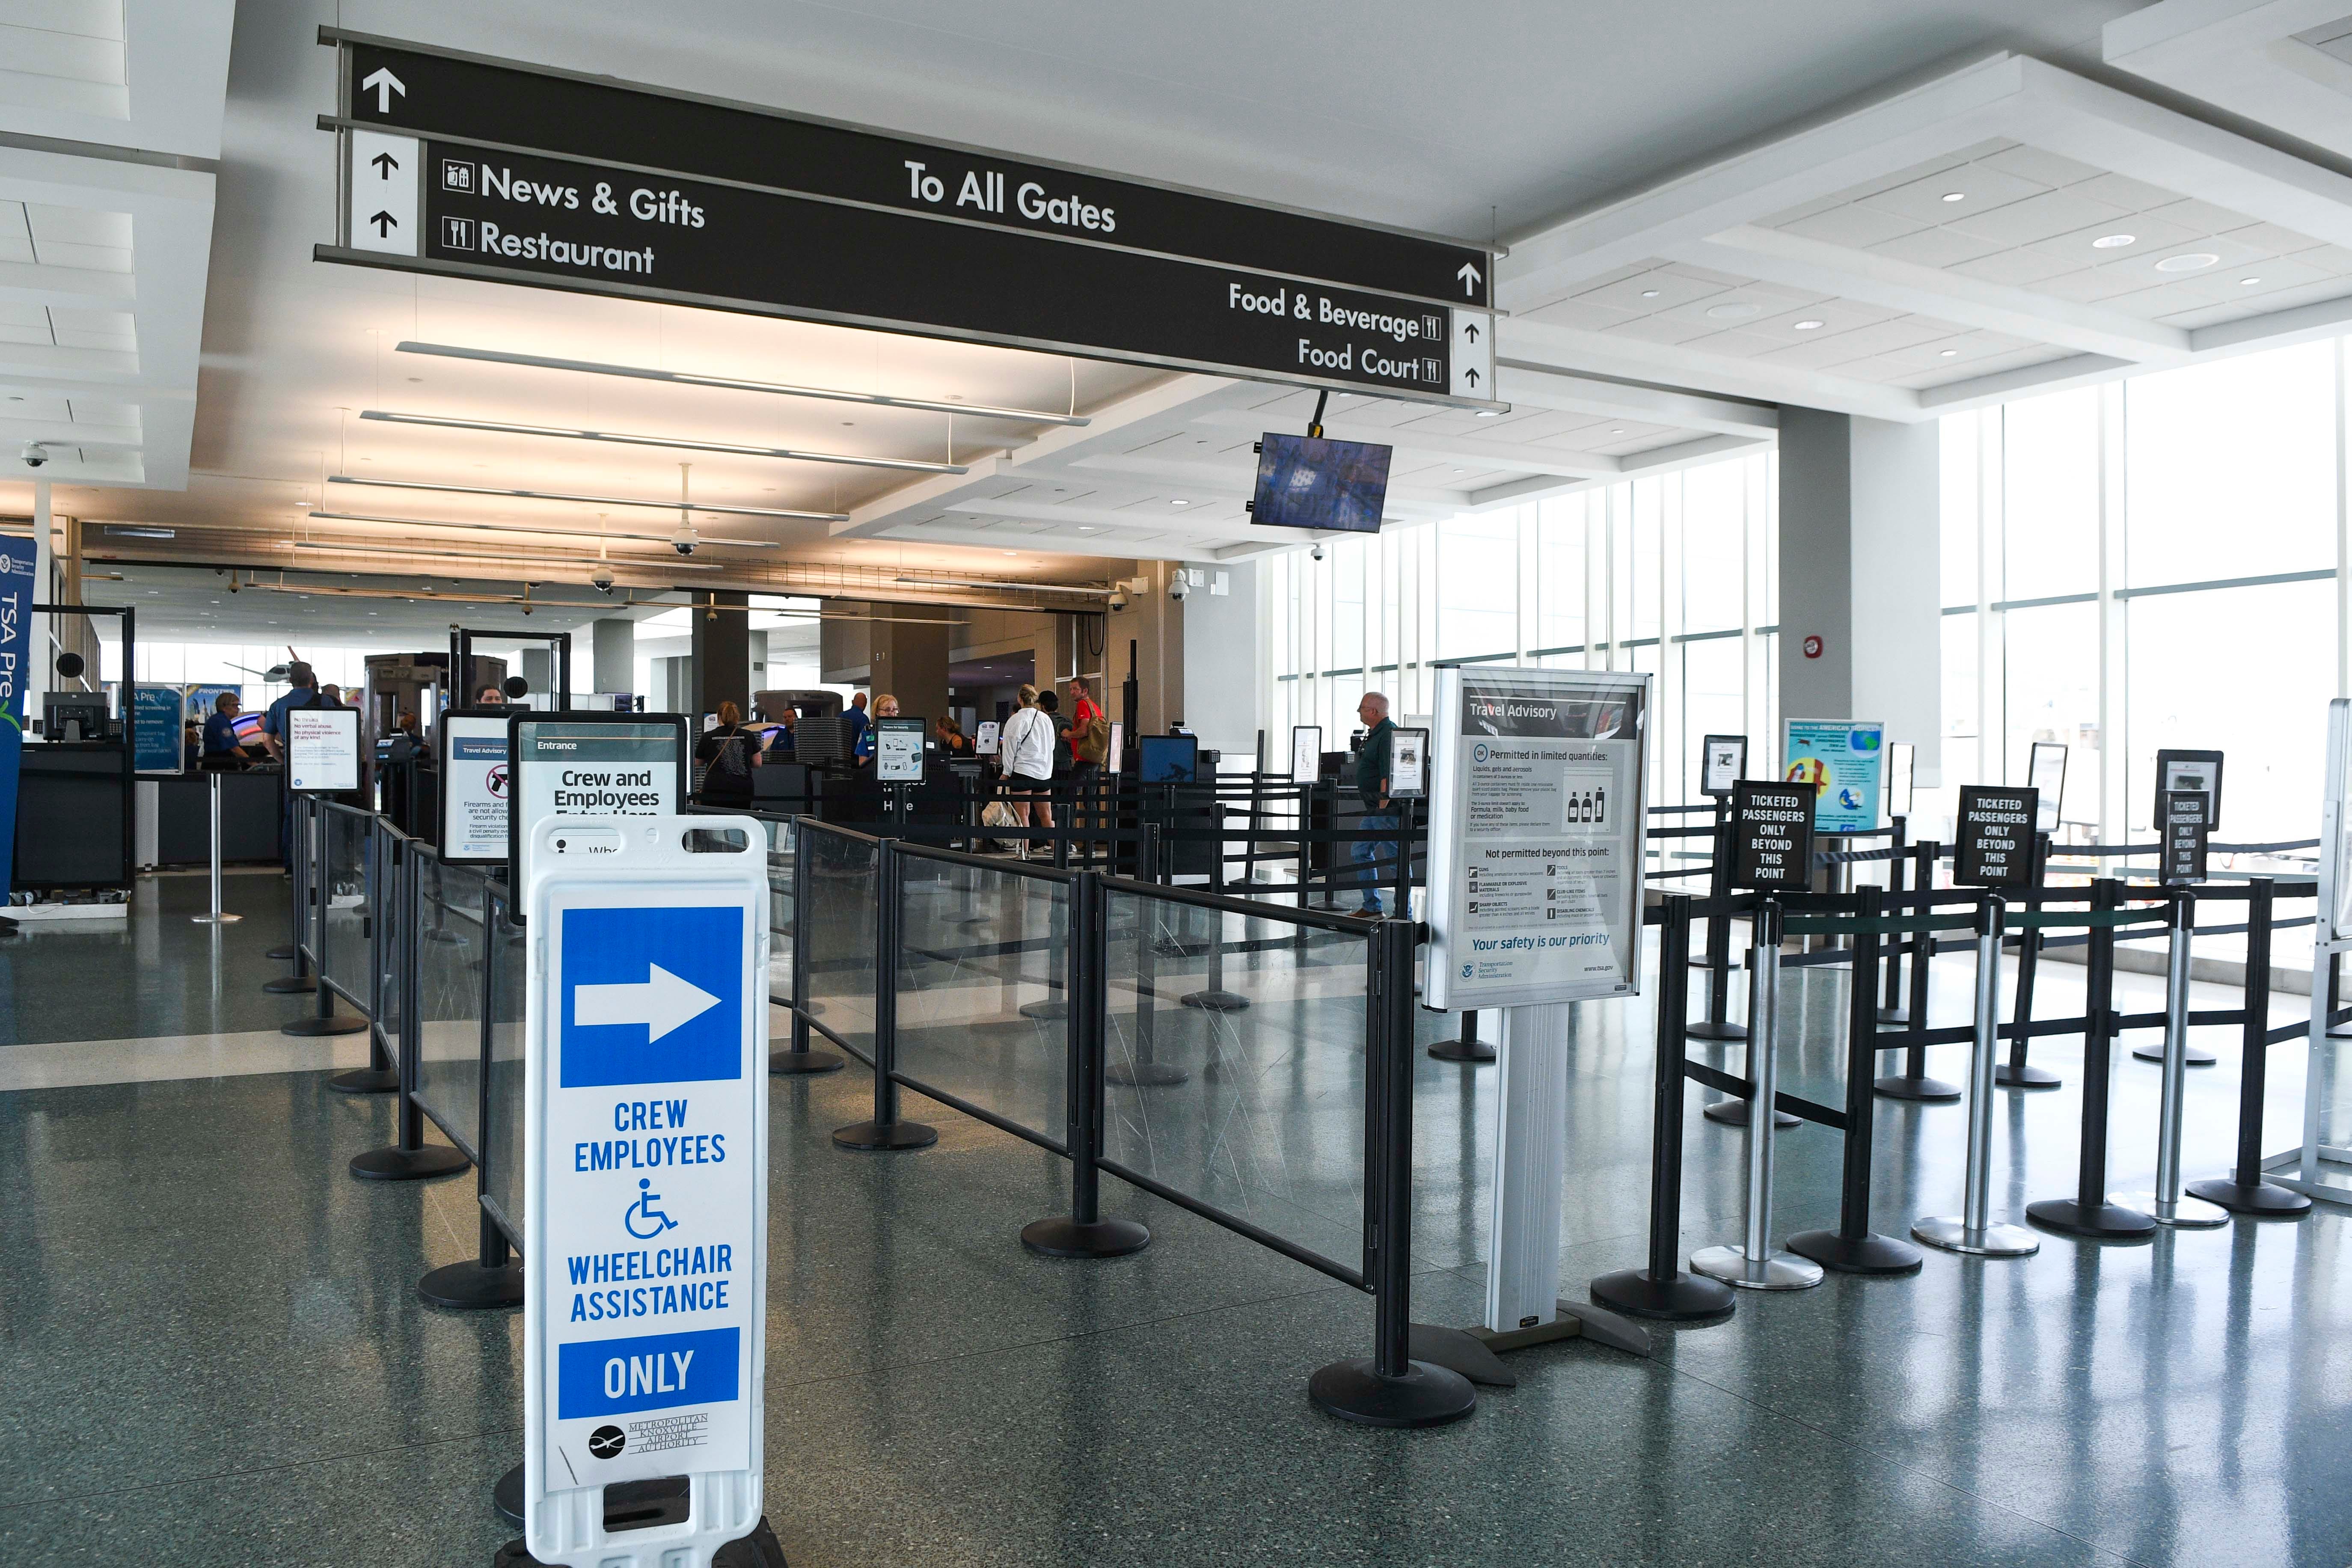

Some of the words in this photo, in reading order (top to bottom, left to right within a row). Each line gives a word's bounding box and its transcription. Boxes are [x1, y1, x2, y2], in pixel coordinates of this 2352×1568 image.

[482, 163, 578, 210] News
[591, 182, 619, 216] &
[630, 188, 705, 229] Gifts
[905, 160, 944, 202] To
[956, 171, 1003, 213] All
[1017, 182, 1115, 232] Gates
[481, 221, 654, 274] Restaurant
[1229, 283, 1285, 316] Food
[1293, 294, 1311, 320] &
[1320, 297, 1419, 342] Beverage
[1299, 338, 1351, 370] Food
[1361, 349, 1419, 379] Court
[0, 592, 17, 644] TSA
[0, 653, 16, 698] Pre
[141, 692, 155, 701] Pre
[1470, 703, 1504, 716] Travel
[1508, 704, 1557, 720] Advisory
[538, 741, 577, 749] Entrance
[1490, 751, 1530, 759] Permitted
[1532, 751, 1538, 759] in
[1541, 751, 1566, 760] limited
[1568, 751, 1607, 763] quantities:
[562, 770, 611, 786] Crew
[616, 770, 651, 786] and
[555, 790, 659, 808] Employees
[884, 801, 913, 811] He
[1751, 795, 1798, 807] TICKETED
[1977, 798, 2022, 810] TICKETED
[1742, 809, 1805, 822] PASSENGERS
[1969, 811, 2028, 823] PASSENGERS
[1760, 824, 1786, 835] ONLY
[1985, 826, 2010, 836] ONLY
[1752, 838, 1792, 850] BEYOND
[1977, 839, 2015, 850] BEYOND
[1486, 849, 1500, 858] Not
[1502, 849, 1540, 859] permitted
[1543, 848, 1570, 858] beyond
[1572, 848, 1586, 856] this
[1588, 847, 1609, 857] point:
[1760, 853, 1782, 864] THIS
[1985, 852, 2006, 863] THIS
[1755, 867, 1785, 879] POINT
[1980, 866, 2008, 876] POINT
[1473, 938, 1498, 950] Your
[1500, 937, 1535, 950] safety
[1537, 935, 1546, 947] is
[1549, 936, 1567, 946] our
[1569, 932, 1610, 947] priority
[615, 1099, 687, 1132] CREW
[575, 1134, 725, 1172] EMPLOYEES
[568, 1244, 732, 1285] WHEELCHAIR
[570, 1280, 728, 1322] ASSISTANCE
[604, 1350, 695, 1399] ONLY
[629, 1414, 708, 1432] METROPOLITAN
[640, 1422, 698, 1437] KNOXVILLE
[638, 1437, 698, 1453] AUTHORITY
[647, 1431, 690, 1444] AIRPORT
